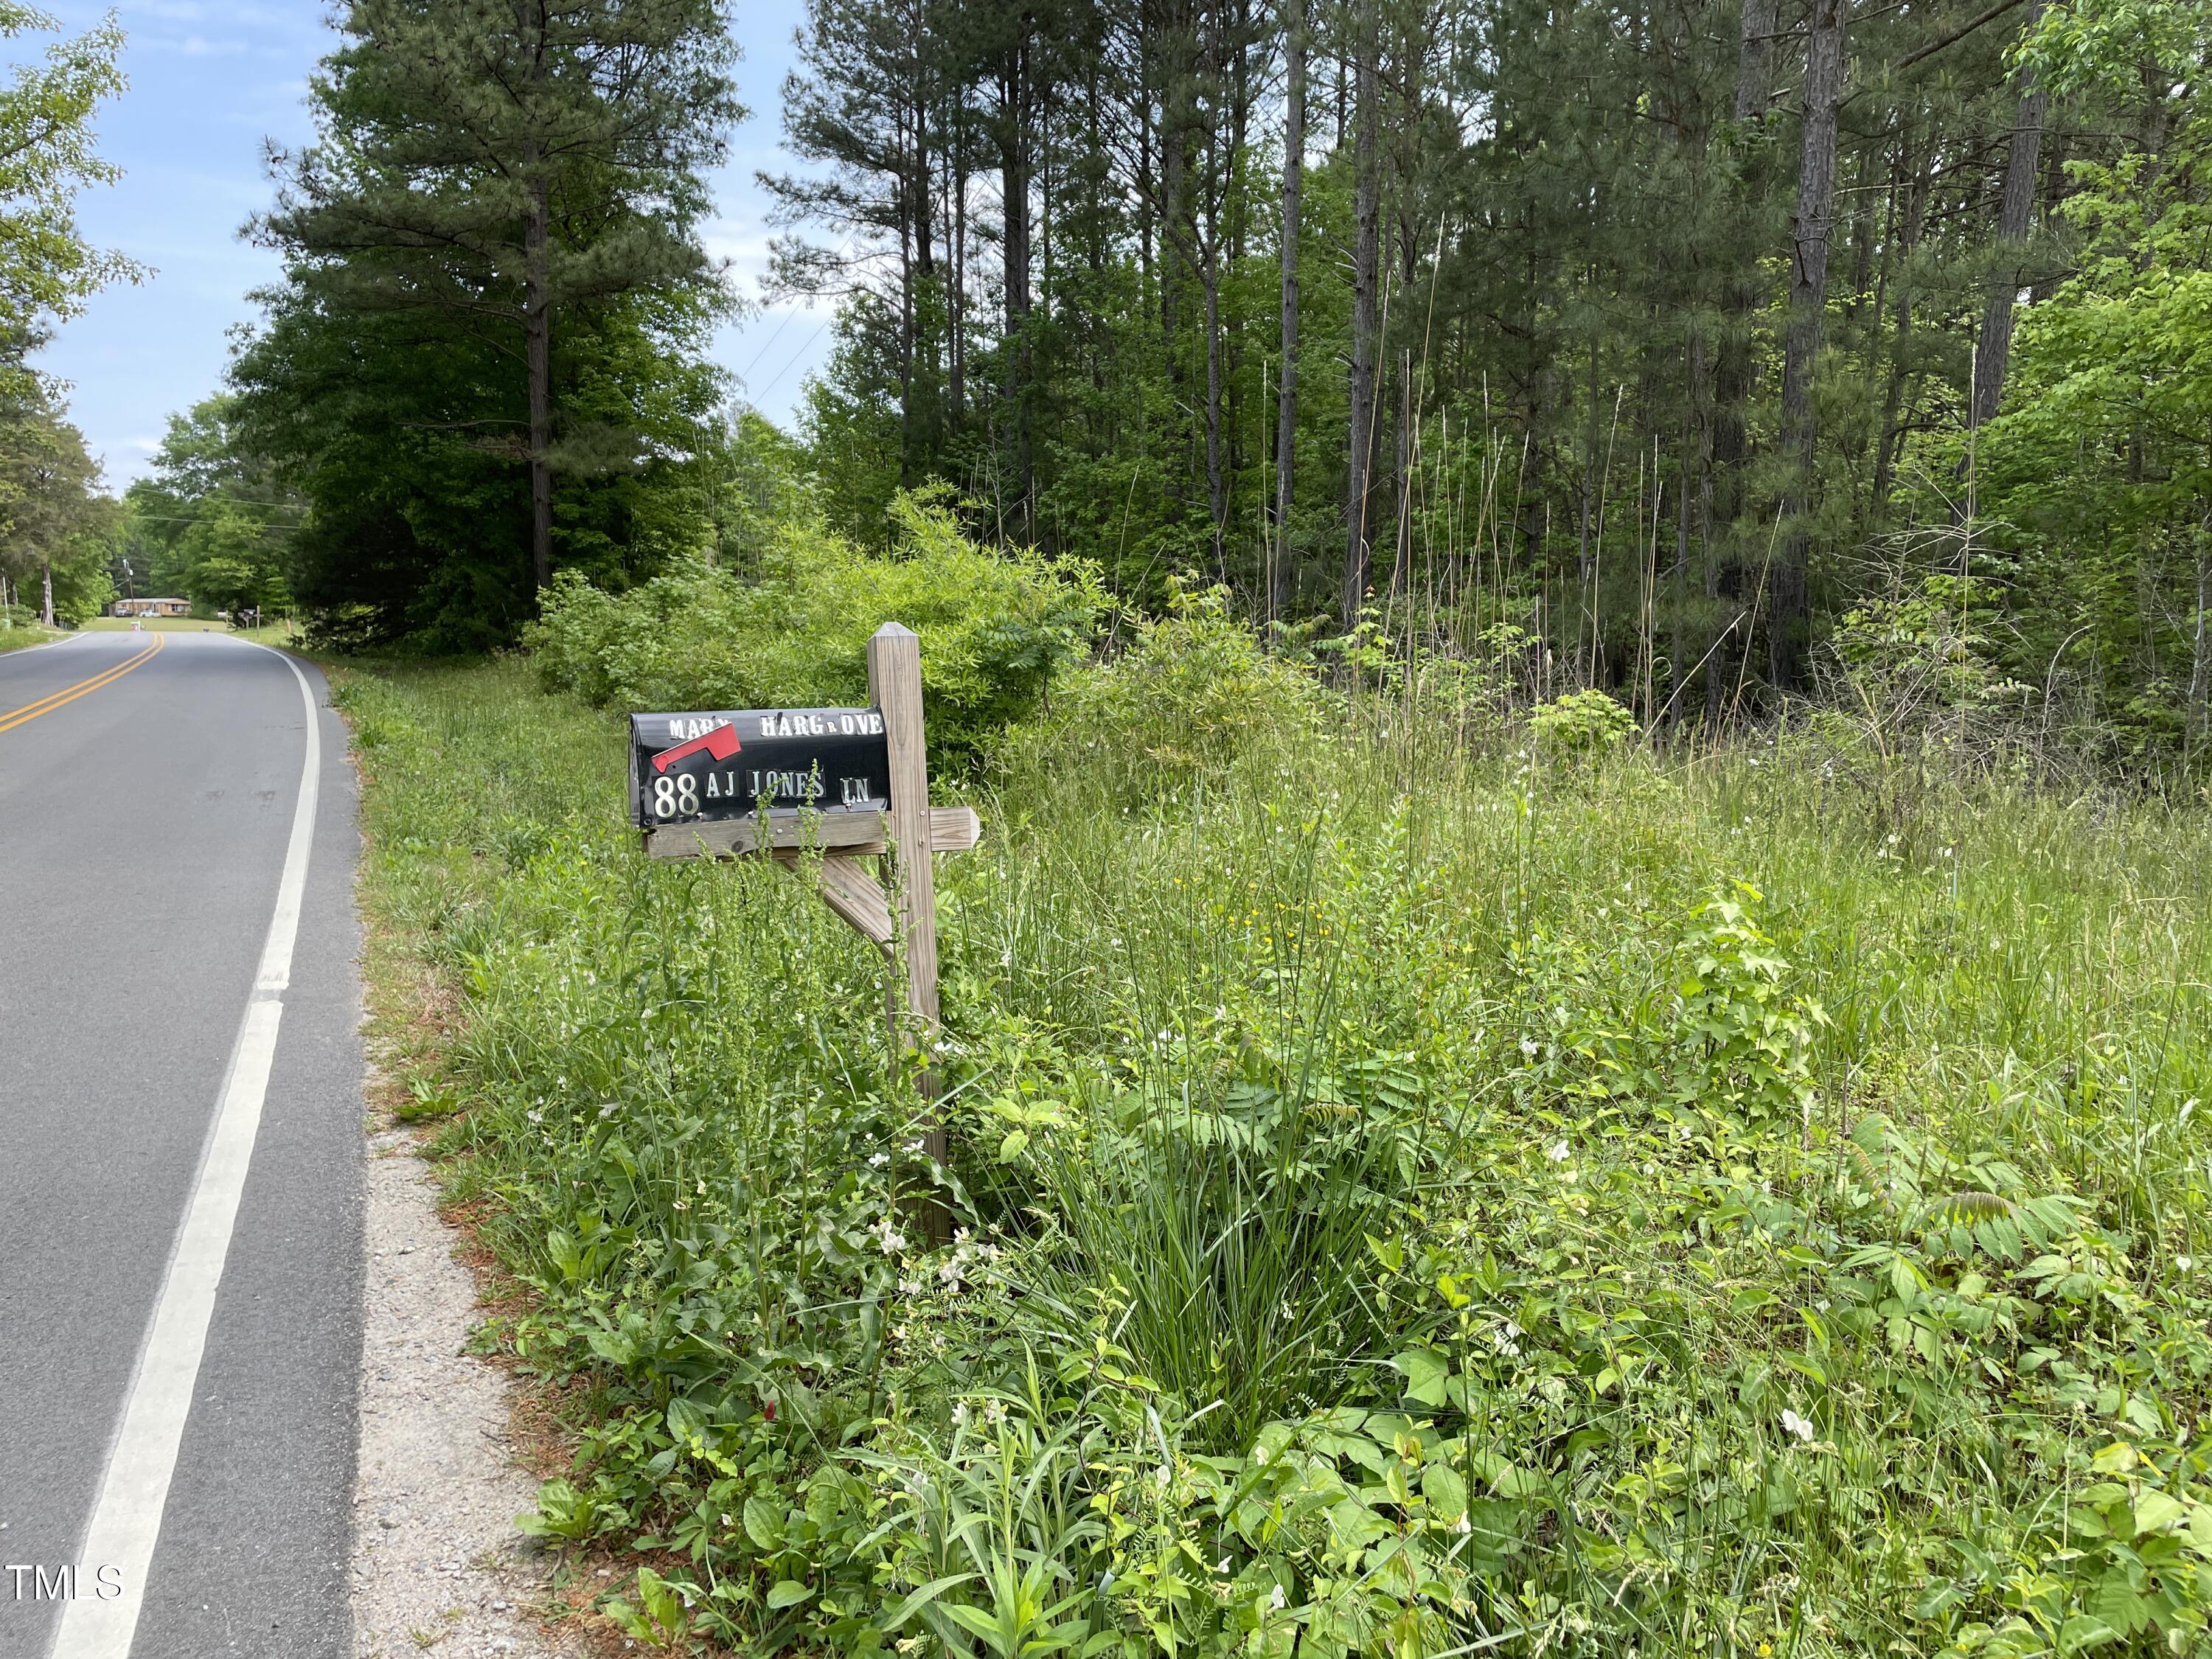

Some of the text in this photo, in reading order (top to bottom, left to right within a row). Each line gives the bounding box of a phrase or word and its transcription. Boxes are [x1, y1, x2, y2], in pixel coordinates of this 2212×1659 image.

[761, 714, 883, 736] HARGROVE
[655, 773, 699, 818] 88
[749, 771, 824, 797] JONES
[841, 778, 869, 804] LN
